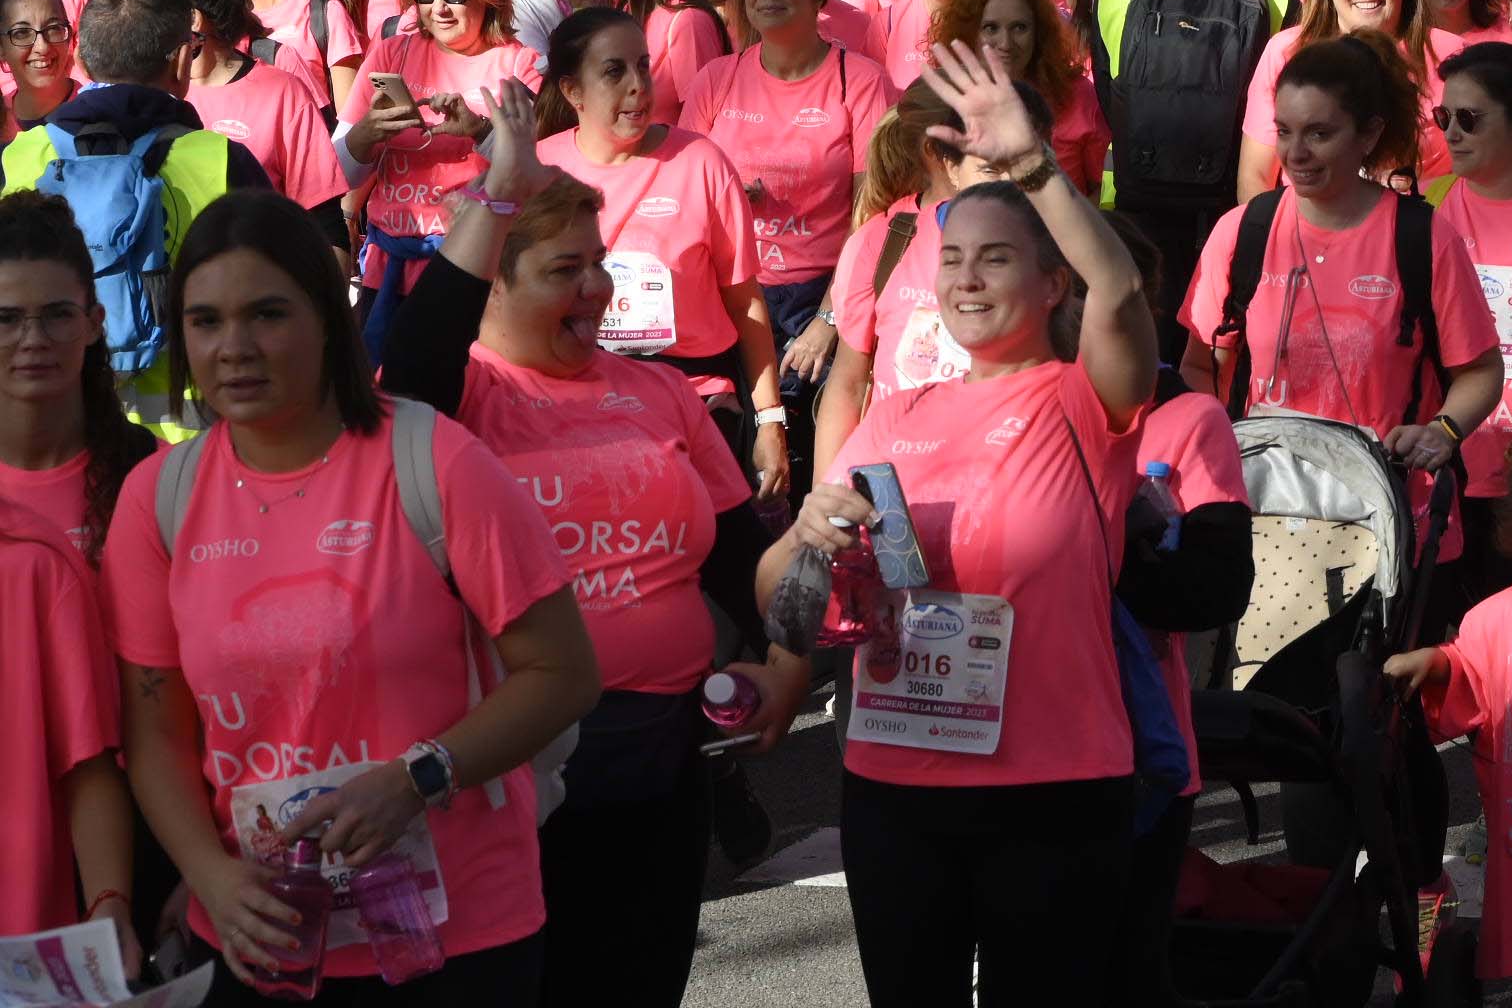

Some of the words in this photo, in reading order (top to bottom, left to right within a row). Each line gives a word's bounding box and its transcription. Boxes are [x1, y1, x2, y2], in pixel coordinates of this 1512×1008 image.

[722, 109, 764, 124] OYSHO
[606, 297, 631, 312] 16
[601, 318, 622, 328] 531
[617, 332, 643, 340] MUJER
[646, 330, 662, 338] 2023
[552, 519, 687, 555] ORSAL
[573, 566, 641, 598] MA
[906, 615, 958, 633] ASTURIANA
[904, 651, 953, 676] 016
[907, 680, 944, 697] 30680
[870, 697, 907, 710] CARRERA
[908, 702, 920, 711] DE
[921, 703, 932, 713] LA
[933, 704, 963, 716] MUJER
[864, 718, 907, 734] OYSHO
[941, 726, 989, 740] Santander
